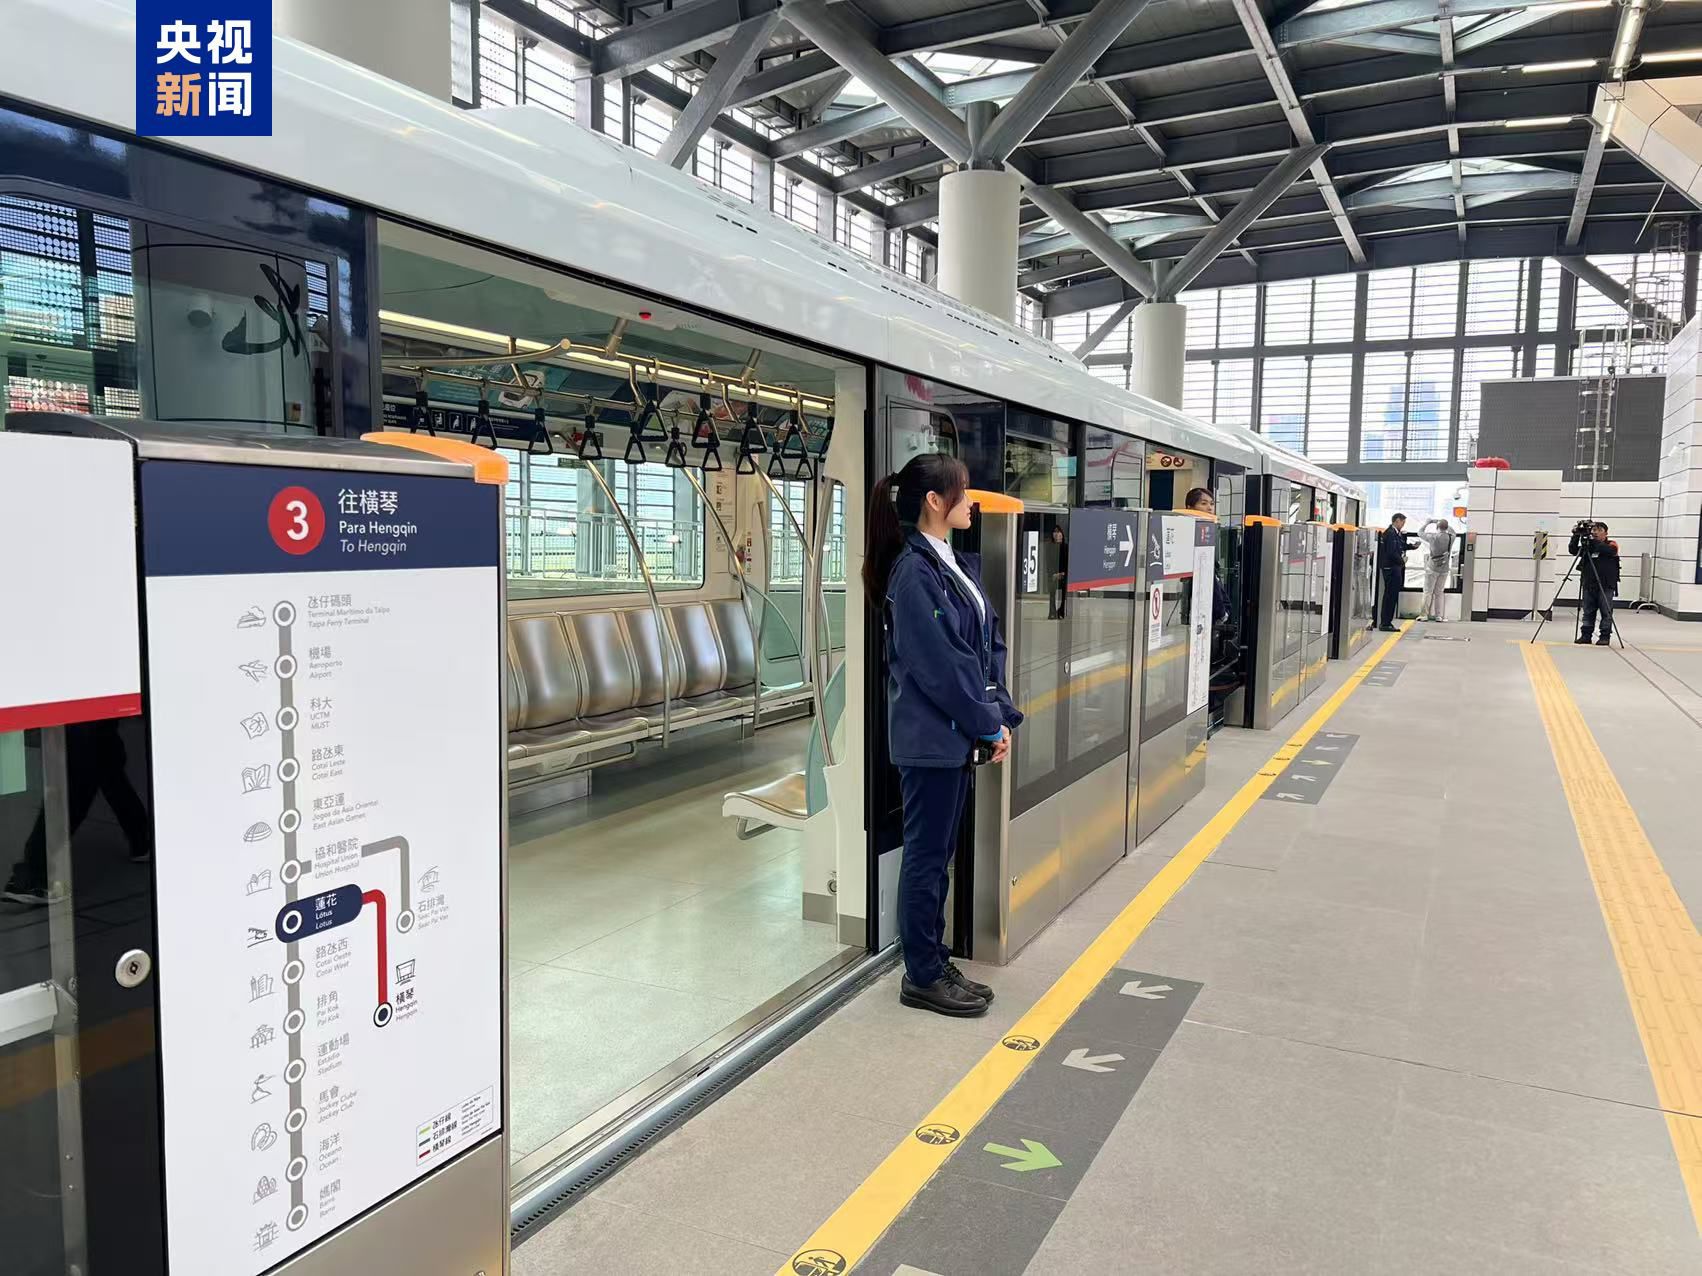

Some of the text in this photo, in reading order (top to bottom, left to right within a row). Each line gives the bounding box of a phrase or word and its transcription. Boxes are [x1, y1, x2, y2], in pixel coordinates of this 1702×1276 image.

[338, 488, 398, 515] 往橫琴
[285, 500, 309, 541] 3
[339, 520, 418, 538] Para Hengqin
[340, 539, 407, 556] To Hengqin
[1029, 545, 1037, 575] 5
[309, 671, 332, 680] Airport
[310, 696, 333, 711] 科大
[310, 711, 330, 721] UCTM
[311, 720, 330, 730] MUST
[315, 892, 337, 911] 蓮花
[315, 919, 333, 930] Lotus
